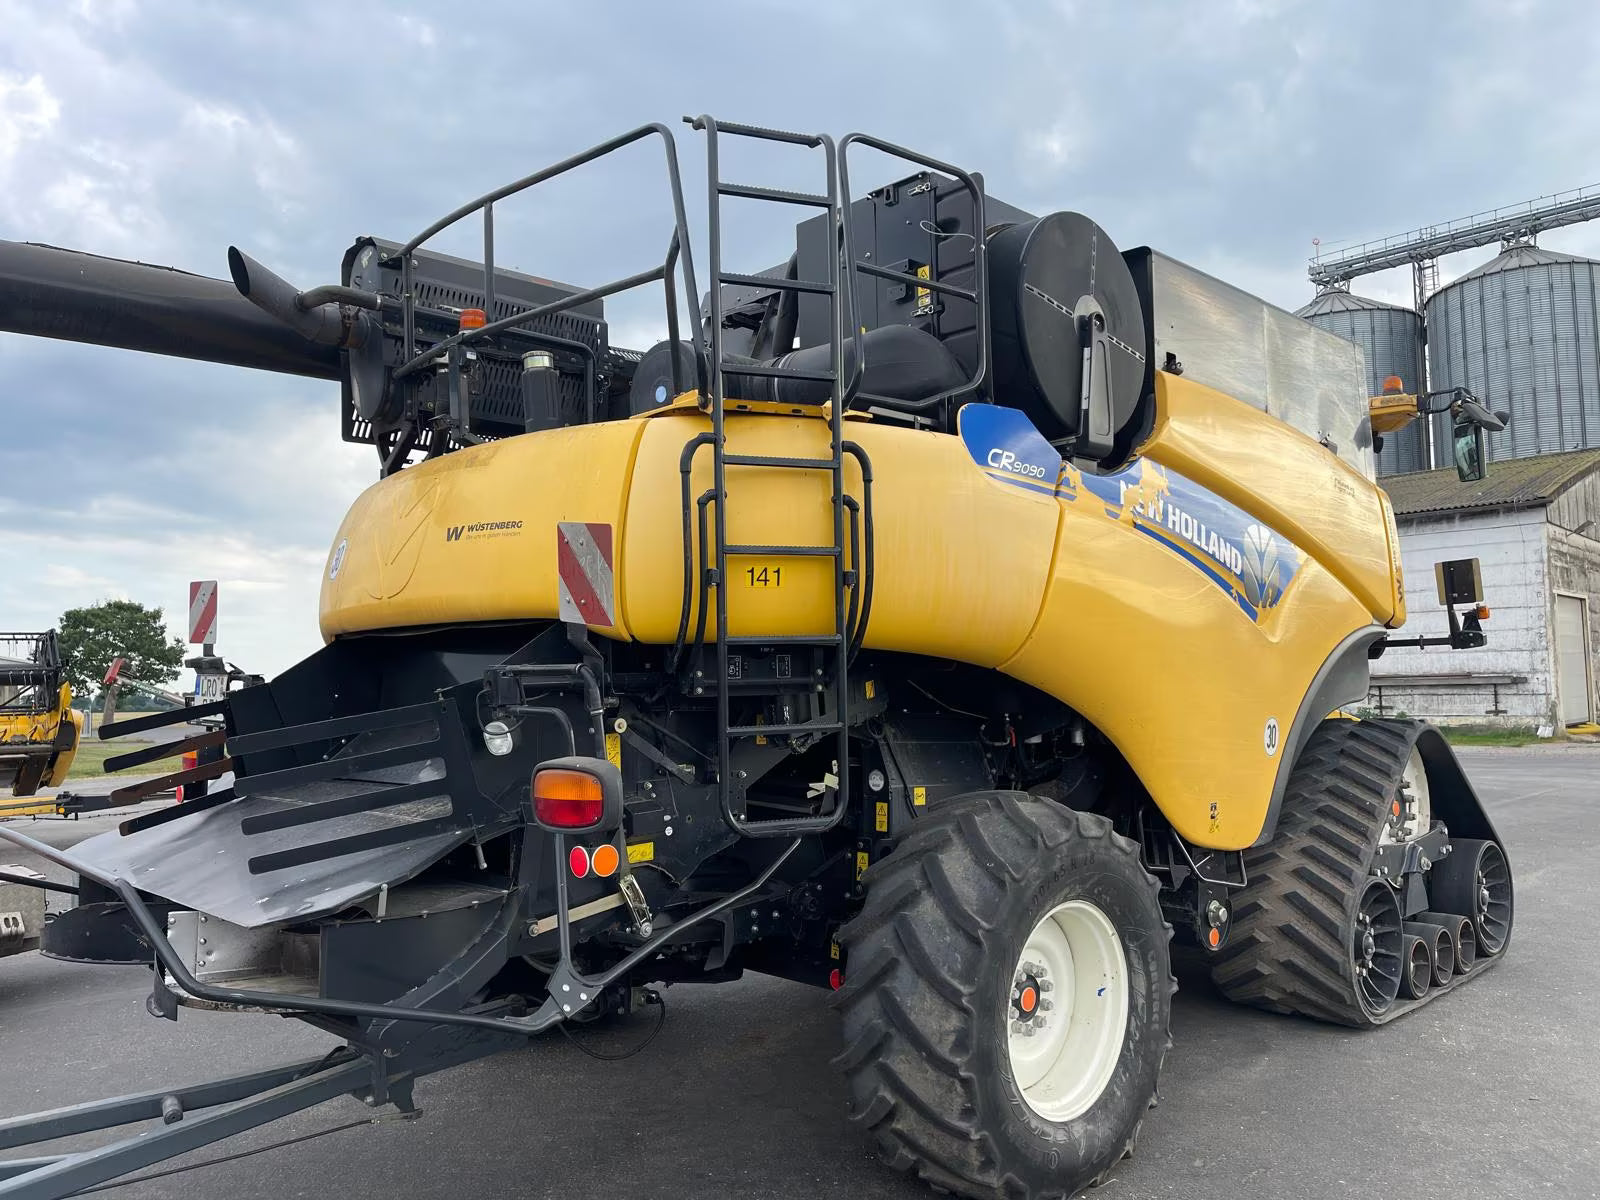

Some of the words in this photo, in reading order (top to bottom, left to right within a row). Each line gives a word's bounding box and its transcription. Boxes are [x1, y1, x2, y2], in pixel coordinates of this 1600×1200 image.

[446, 526, 465, 542] W
[467, 520, 523, 533] WÜSTENBERG
[1167, 503, 1243, 576] HOLLAND
[746, 566, 781, 587] 141
[201, 678, 218, 698] LRO
[1266, 723, 1277, 749] 30
